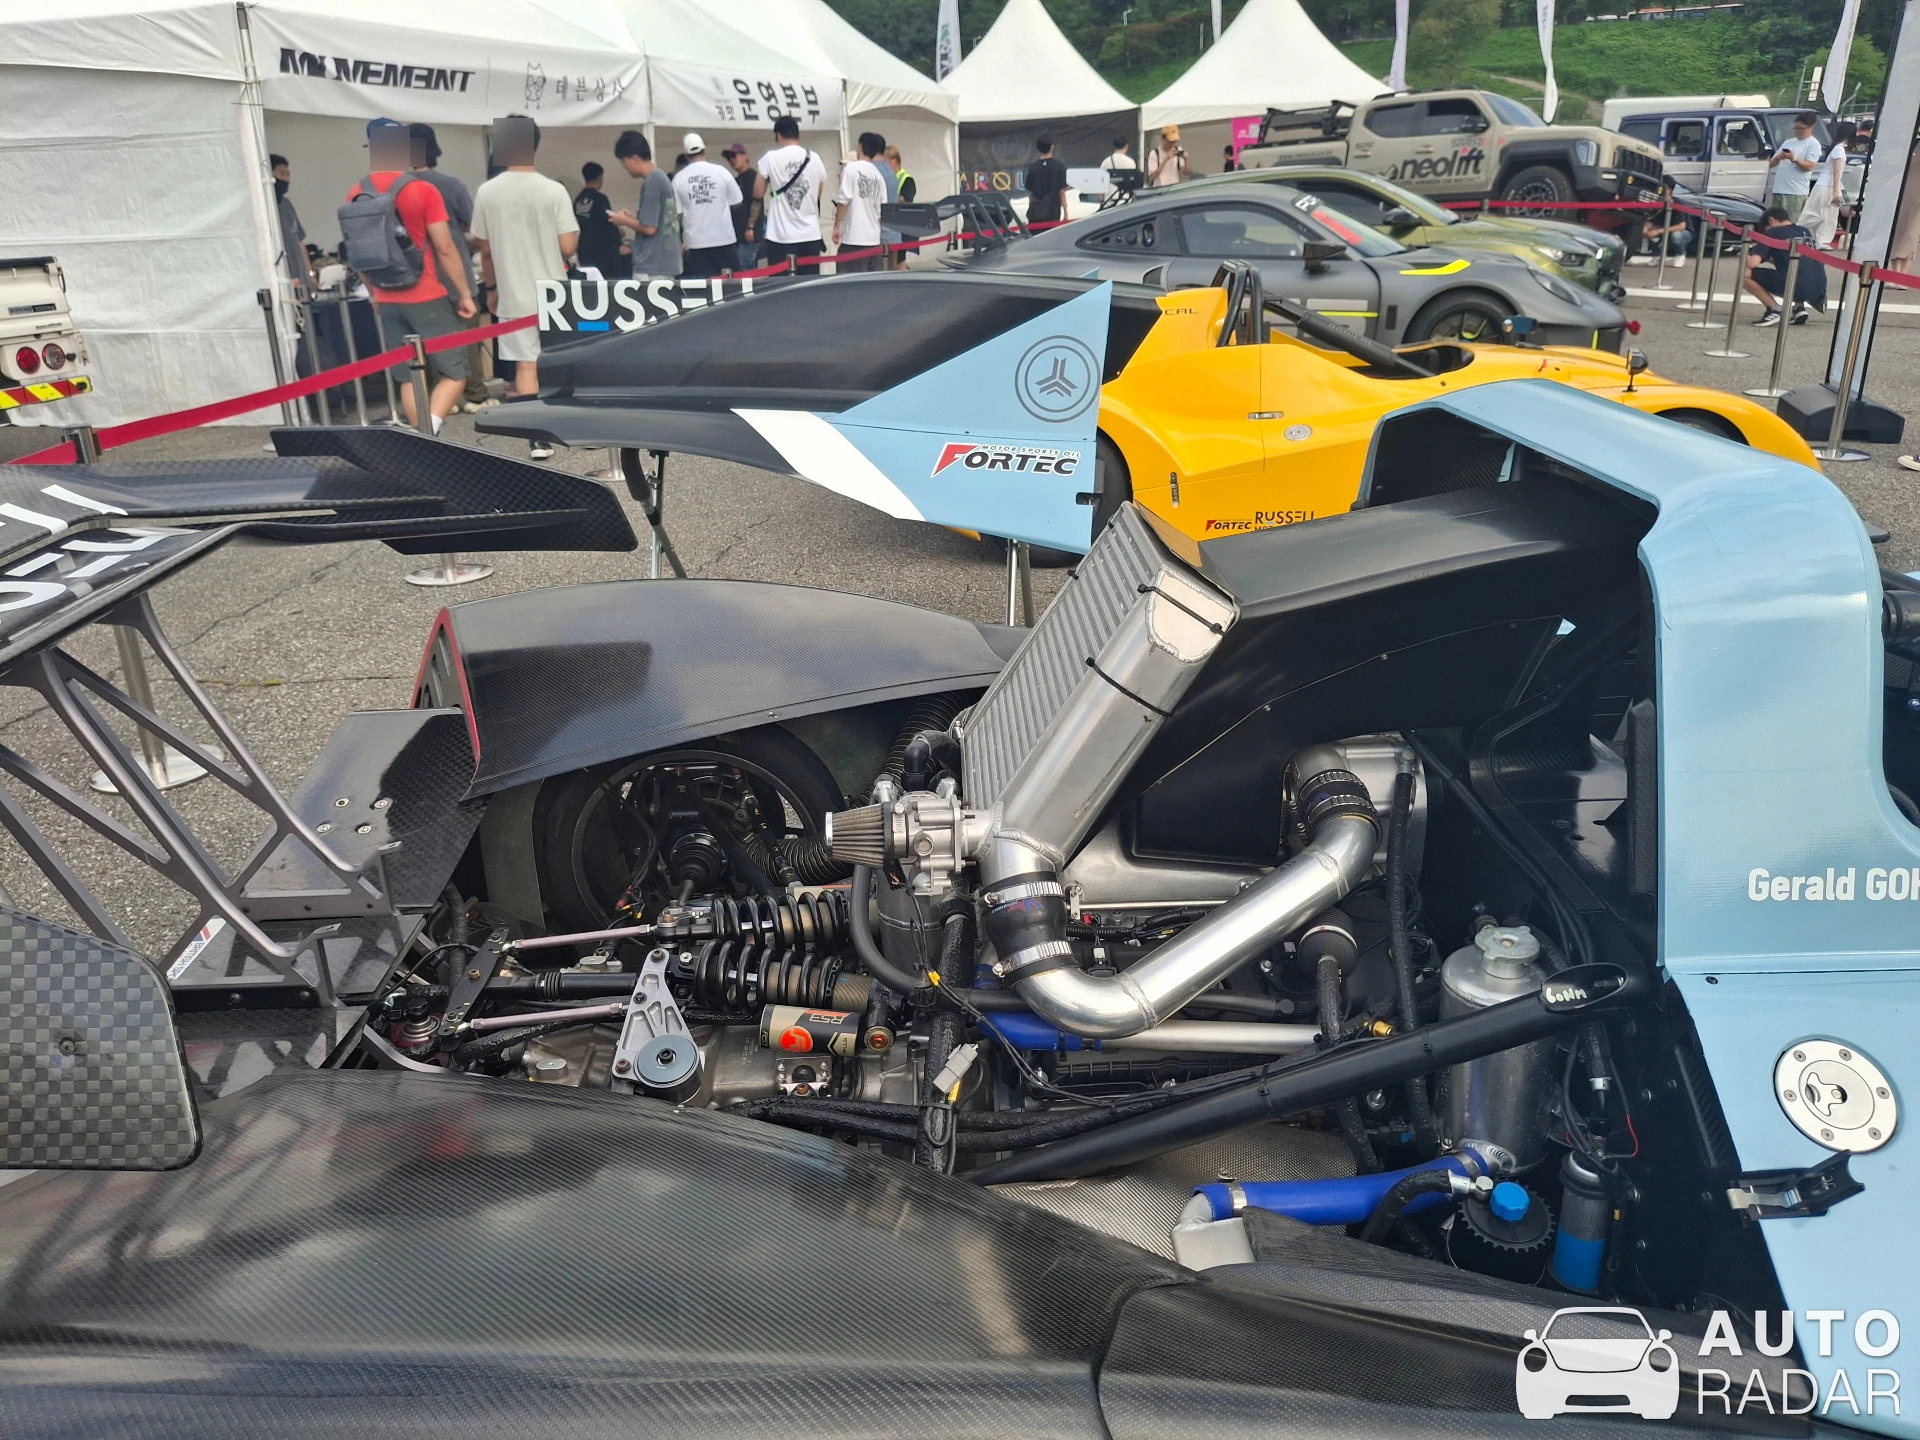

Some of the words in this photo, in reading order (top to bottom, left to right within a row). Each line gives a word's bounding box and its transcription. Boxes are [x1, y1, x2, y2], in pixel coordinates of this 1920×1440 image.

[732, 79, 820, 124] 운영본부
[1399, 148, 1485, 180] neolift
[933, 443, 1078, 476] FORTEC
[1021, 447, 1059, 456] SPORTS
[1205, 519, 1252, 533] FORTEC
[1748, 867, 1856, 901] Gerald
